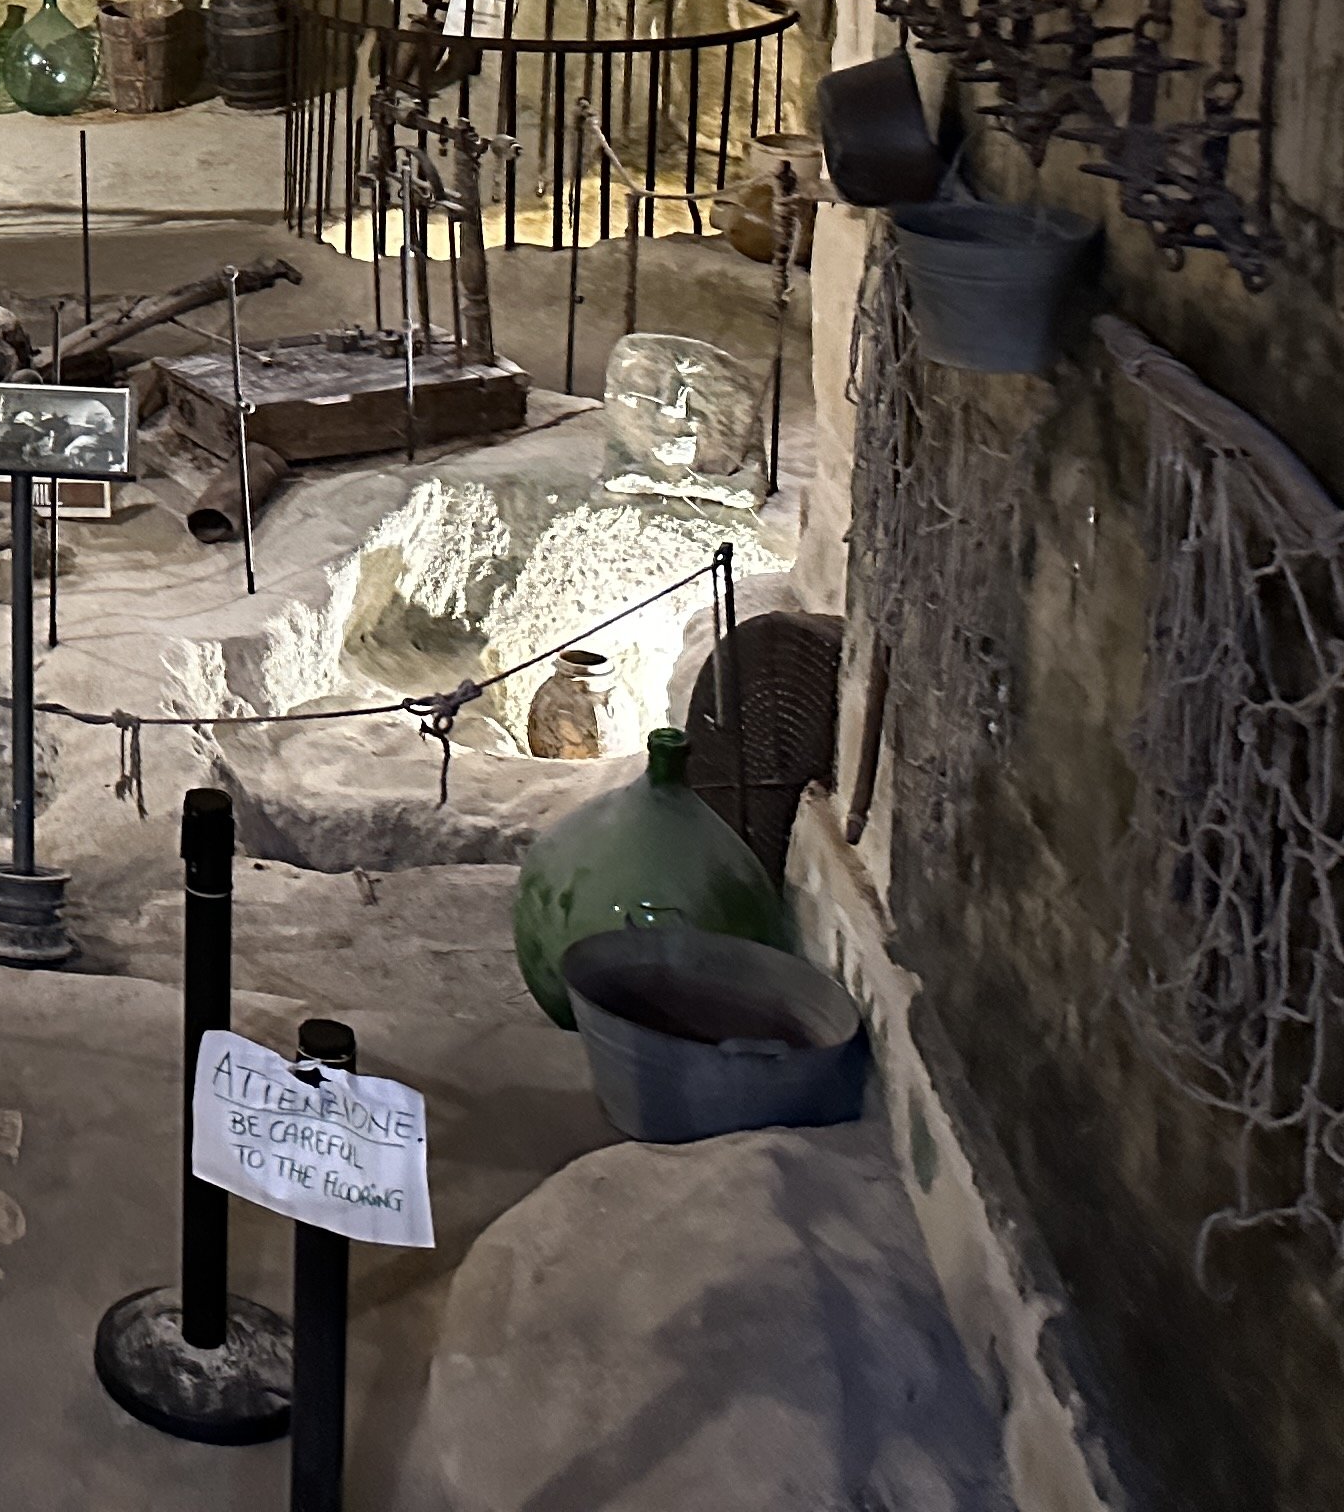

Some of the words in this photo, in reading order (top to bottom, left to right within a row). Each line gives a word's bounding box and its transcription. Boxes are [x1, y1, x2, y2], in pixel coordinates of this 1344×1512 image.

[228, 1110, 262, 1138] BE
[269, 1120, 364, 1170] CAREFUL
[229, 1143, 265, 1169] TO
[272, 1153, 318, 1189] THE
